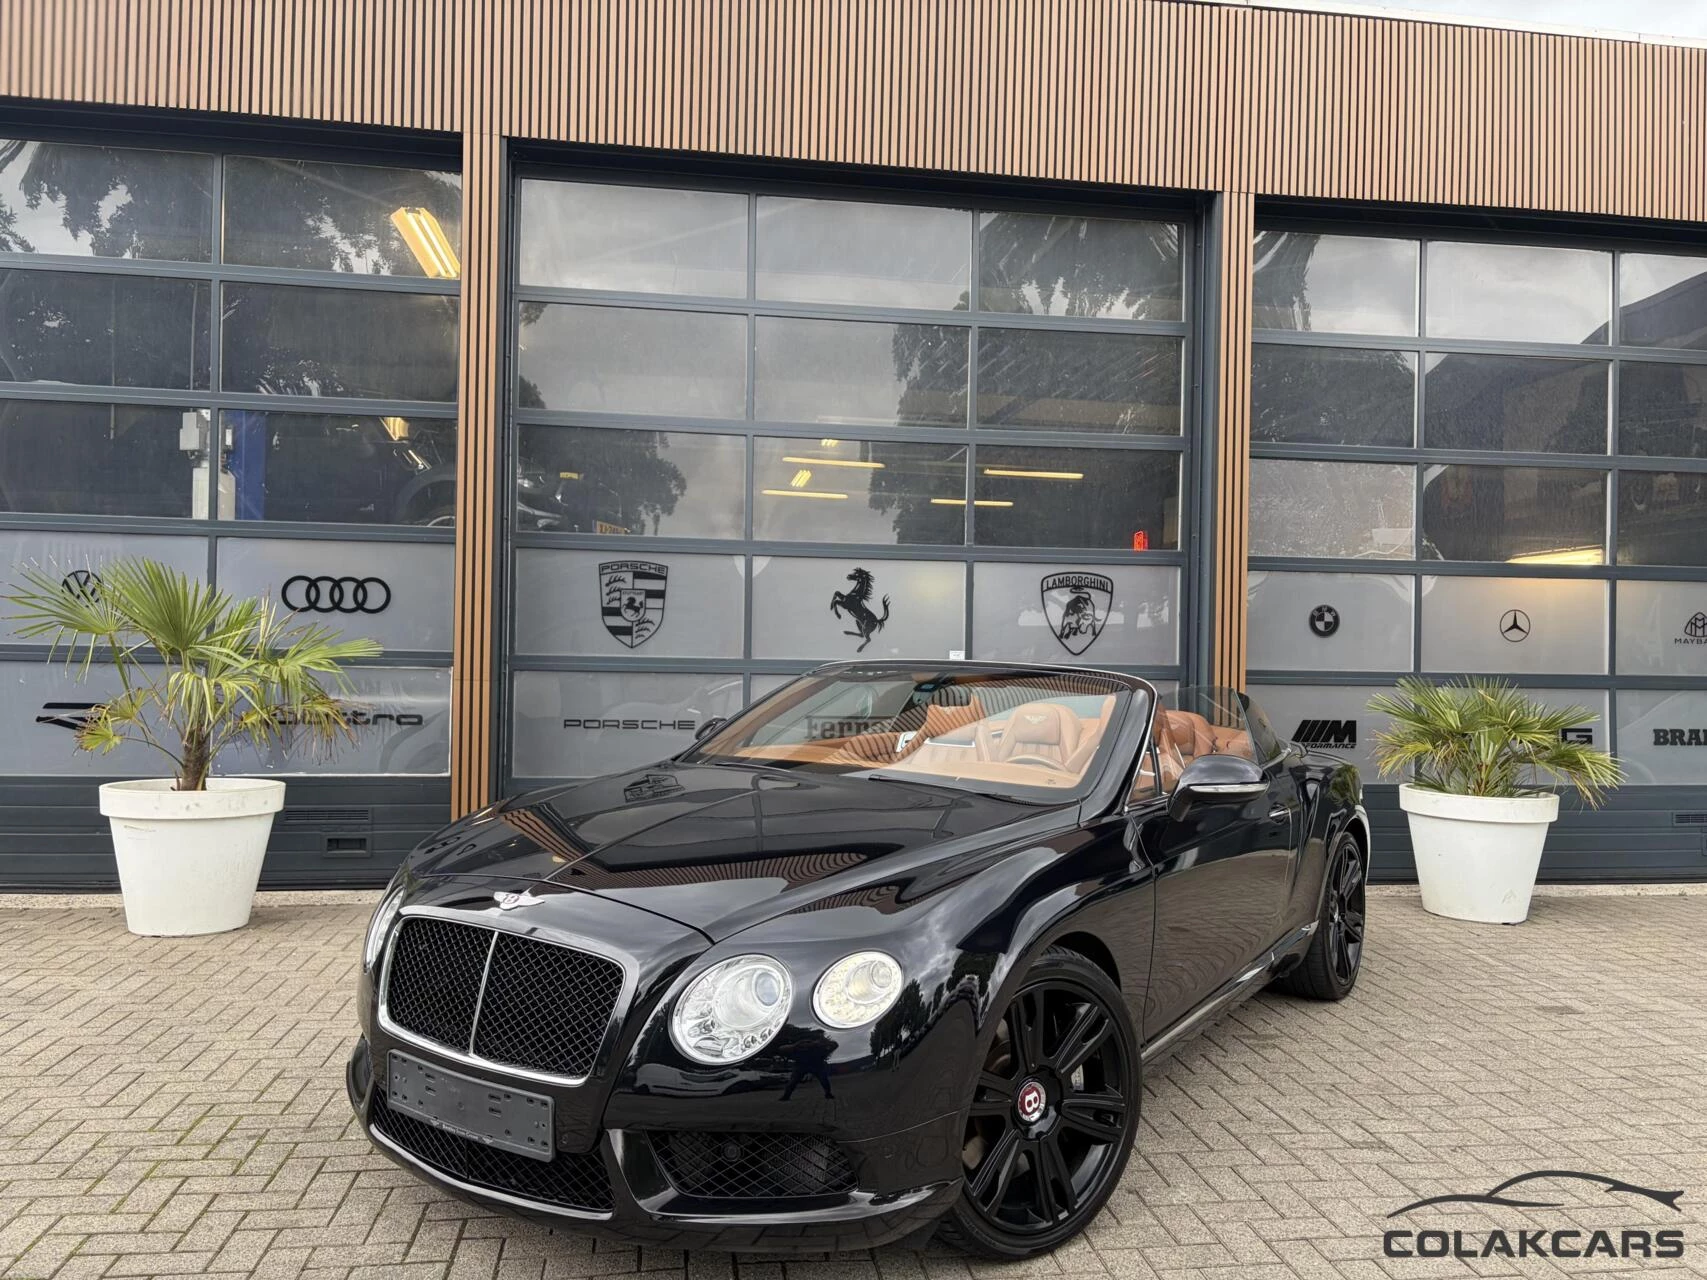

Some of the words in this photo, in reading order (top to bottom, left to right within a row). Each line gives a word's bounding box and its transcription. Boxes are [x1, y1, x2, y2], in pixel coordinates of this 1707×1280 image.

[601, 562, 666, 575] PORSCHE
[1046, 575, 1109, 591] LAMBORGHINI
[563, 719, 696, 730] PORSCHE
[804, 715, 897, 739] Ferr
[1653, 728, 1707, 746] BRA
